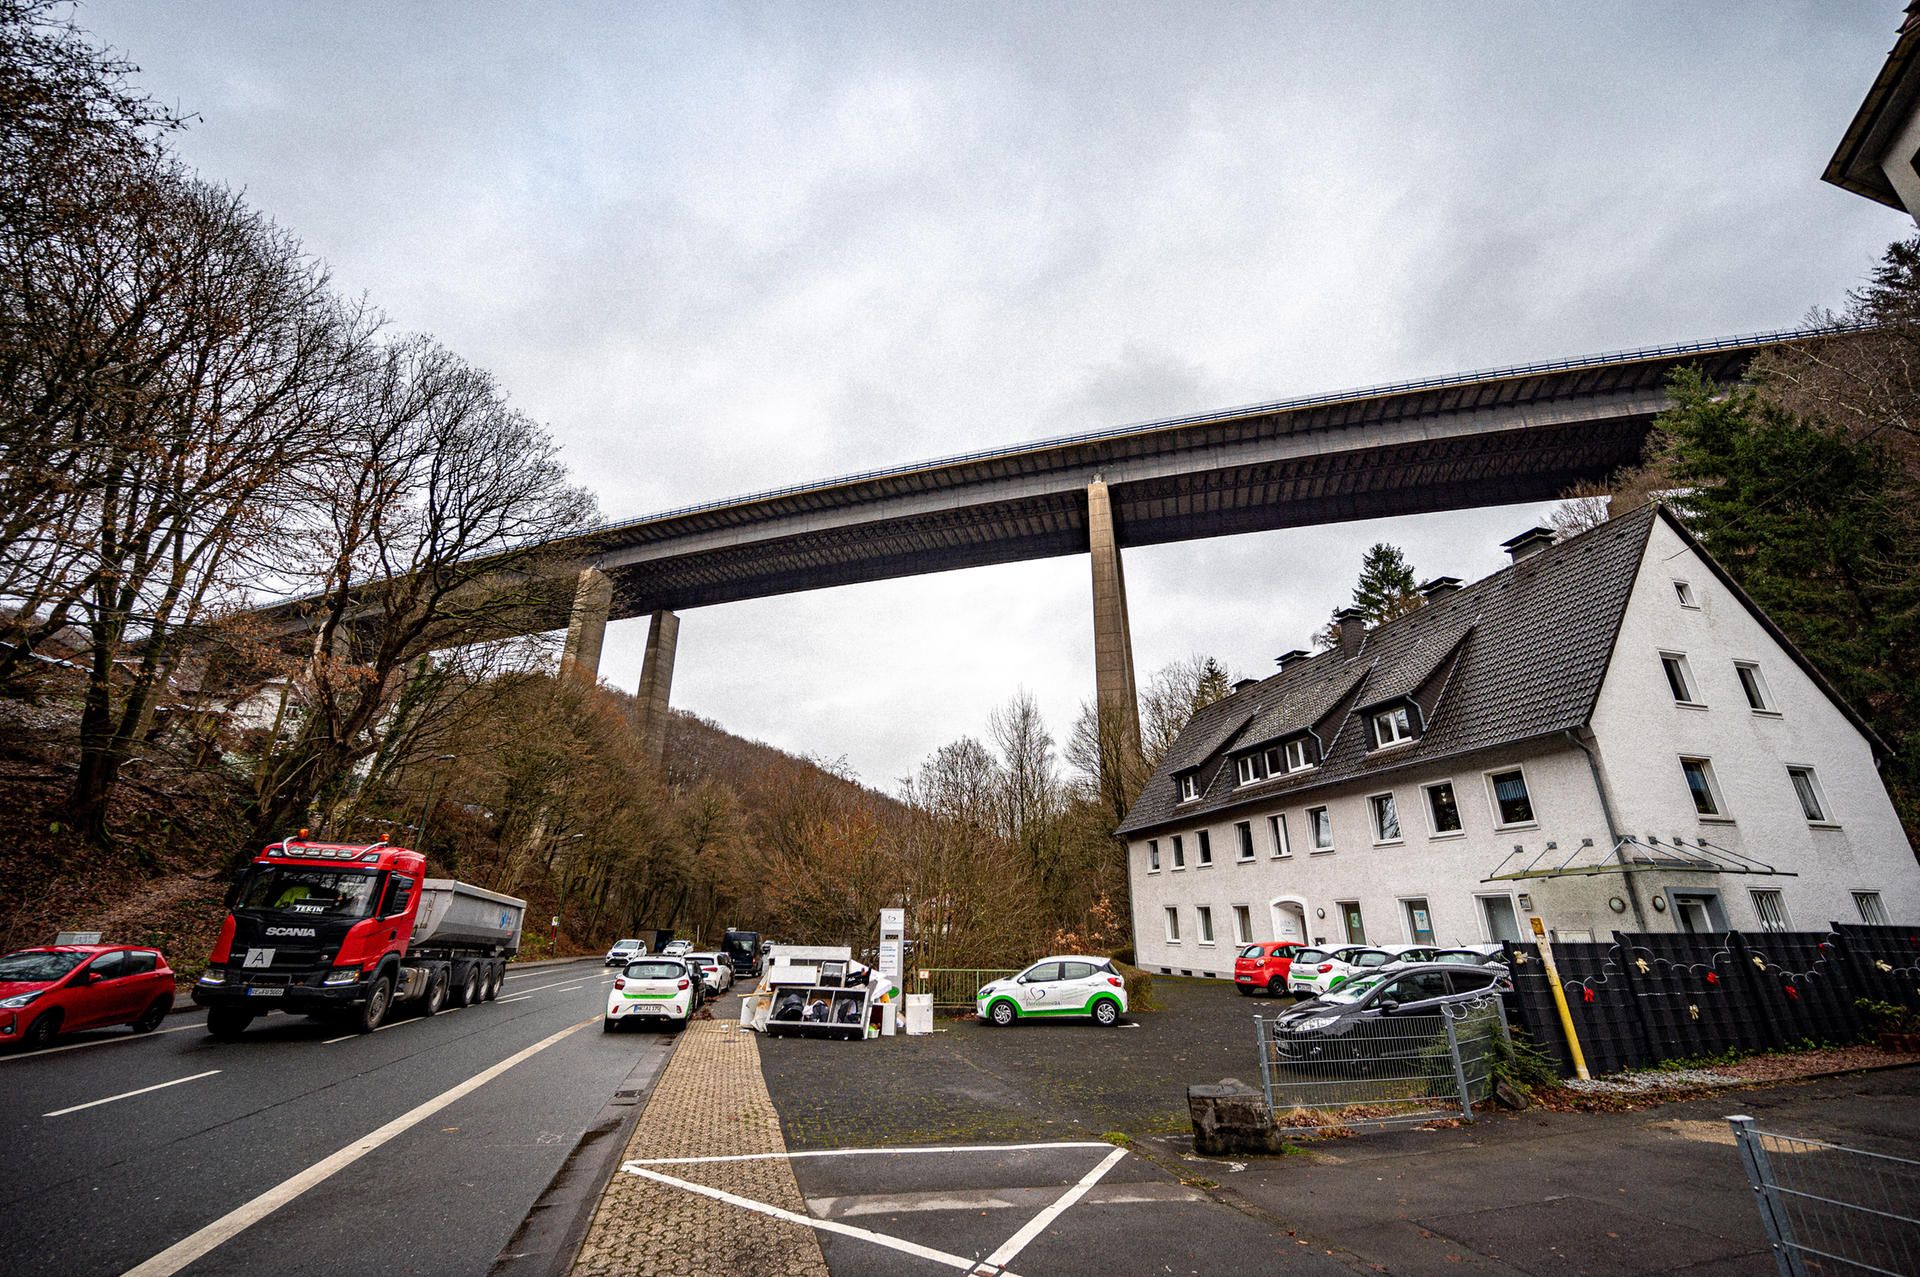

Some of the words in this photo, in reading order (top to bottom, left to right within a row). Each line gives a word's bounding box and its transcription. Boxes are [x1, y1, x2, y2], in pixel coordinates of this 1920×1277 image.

[294, 904, 325, 914] TEKIN
[265, 927, 316, 936] SCANIA
[251, 951, 264, 965] A
